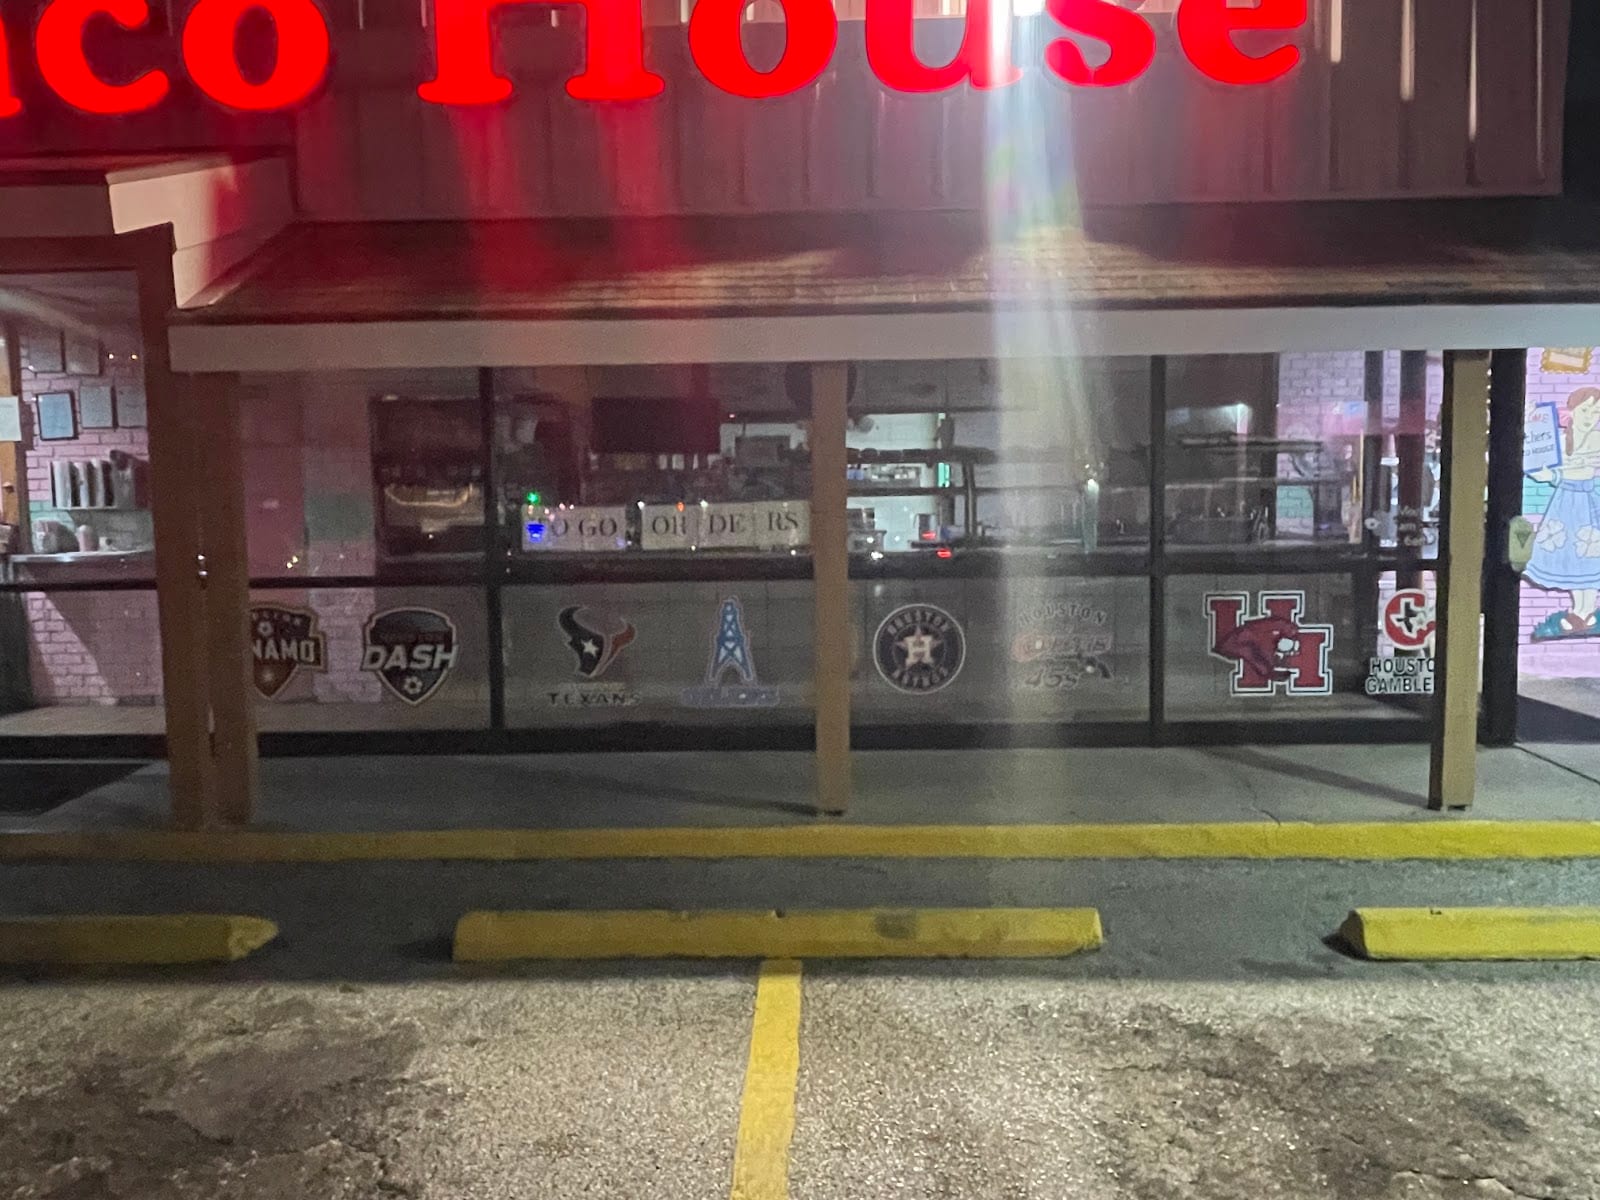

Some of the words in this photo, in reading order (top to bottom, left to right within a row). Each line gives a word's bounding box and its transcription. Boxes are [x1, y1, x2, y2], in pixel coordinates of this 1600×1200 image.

[418, 0, 1306, 106] House
[577, 516, 618, 538] GO
[364, 644, 459, 670] DASH
[1366, 677, 1434, 693] GAMBLE
